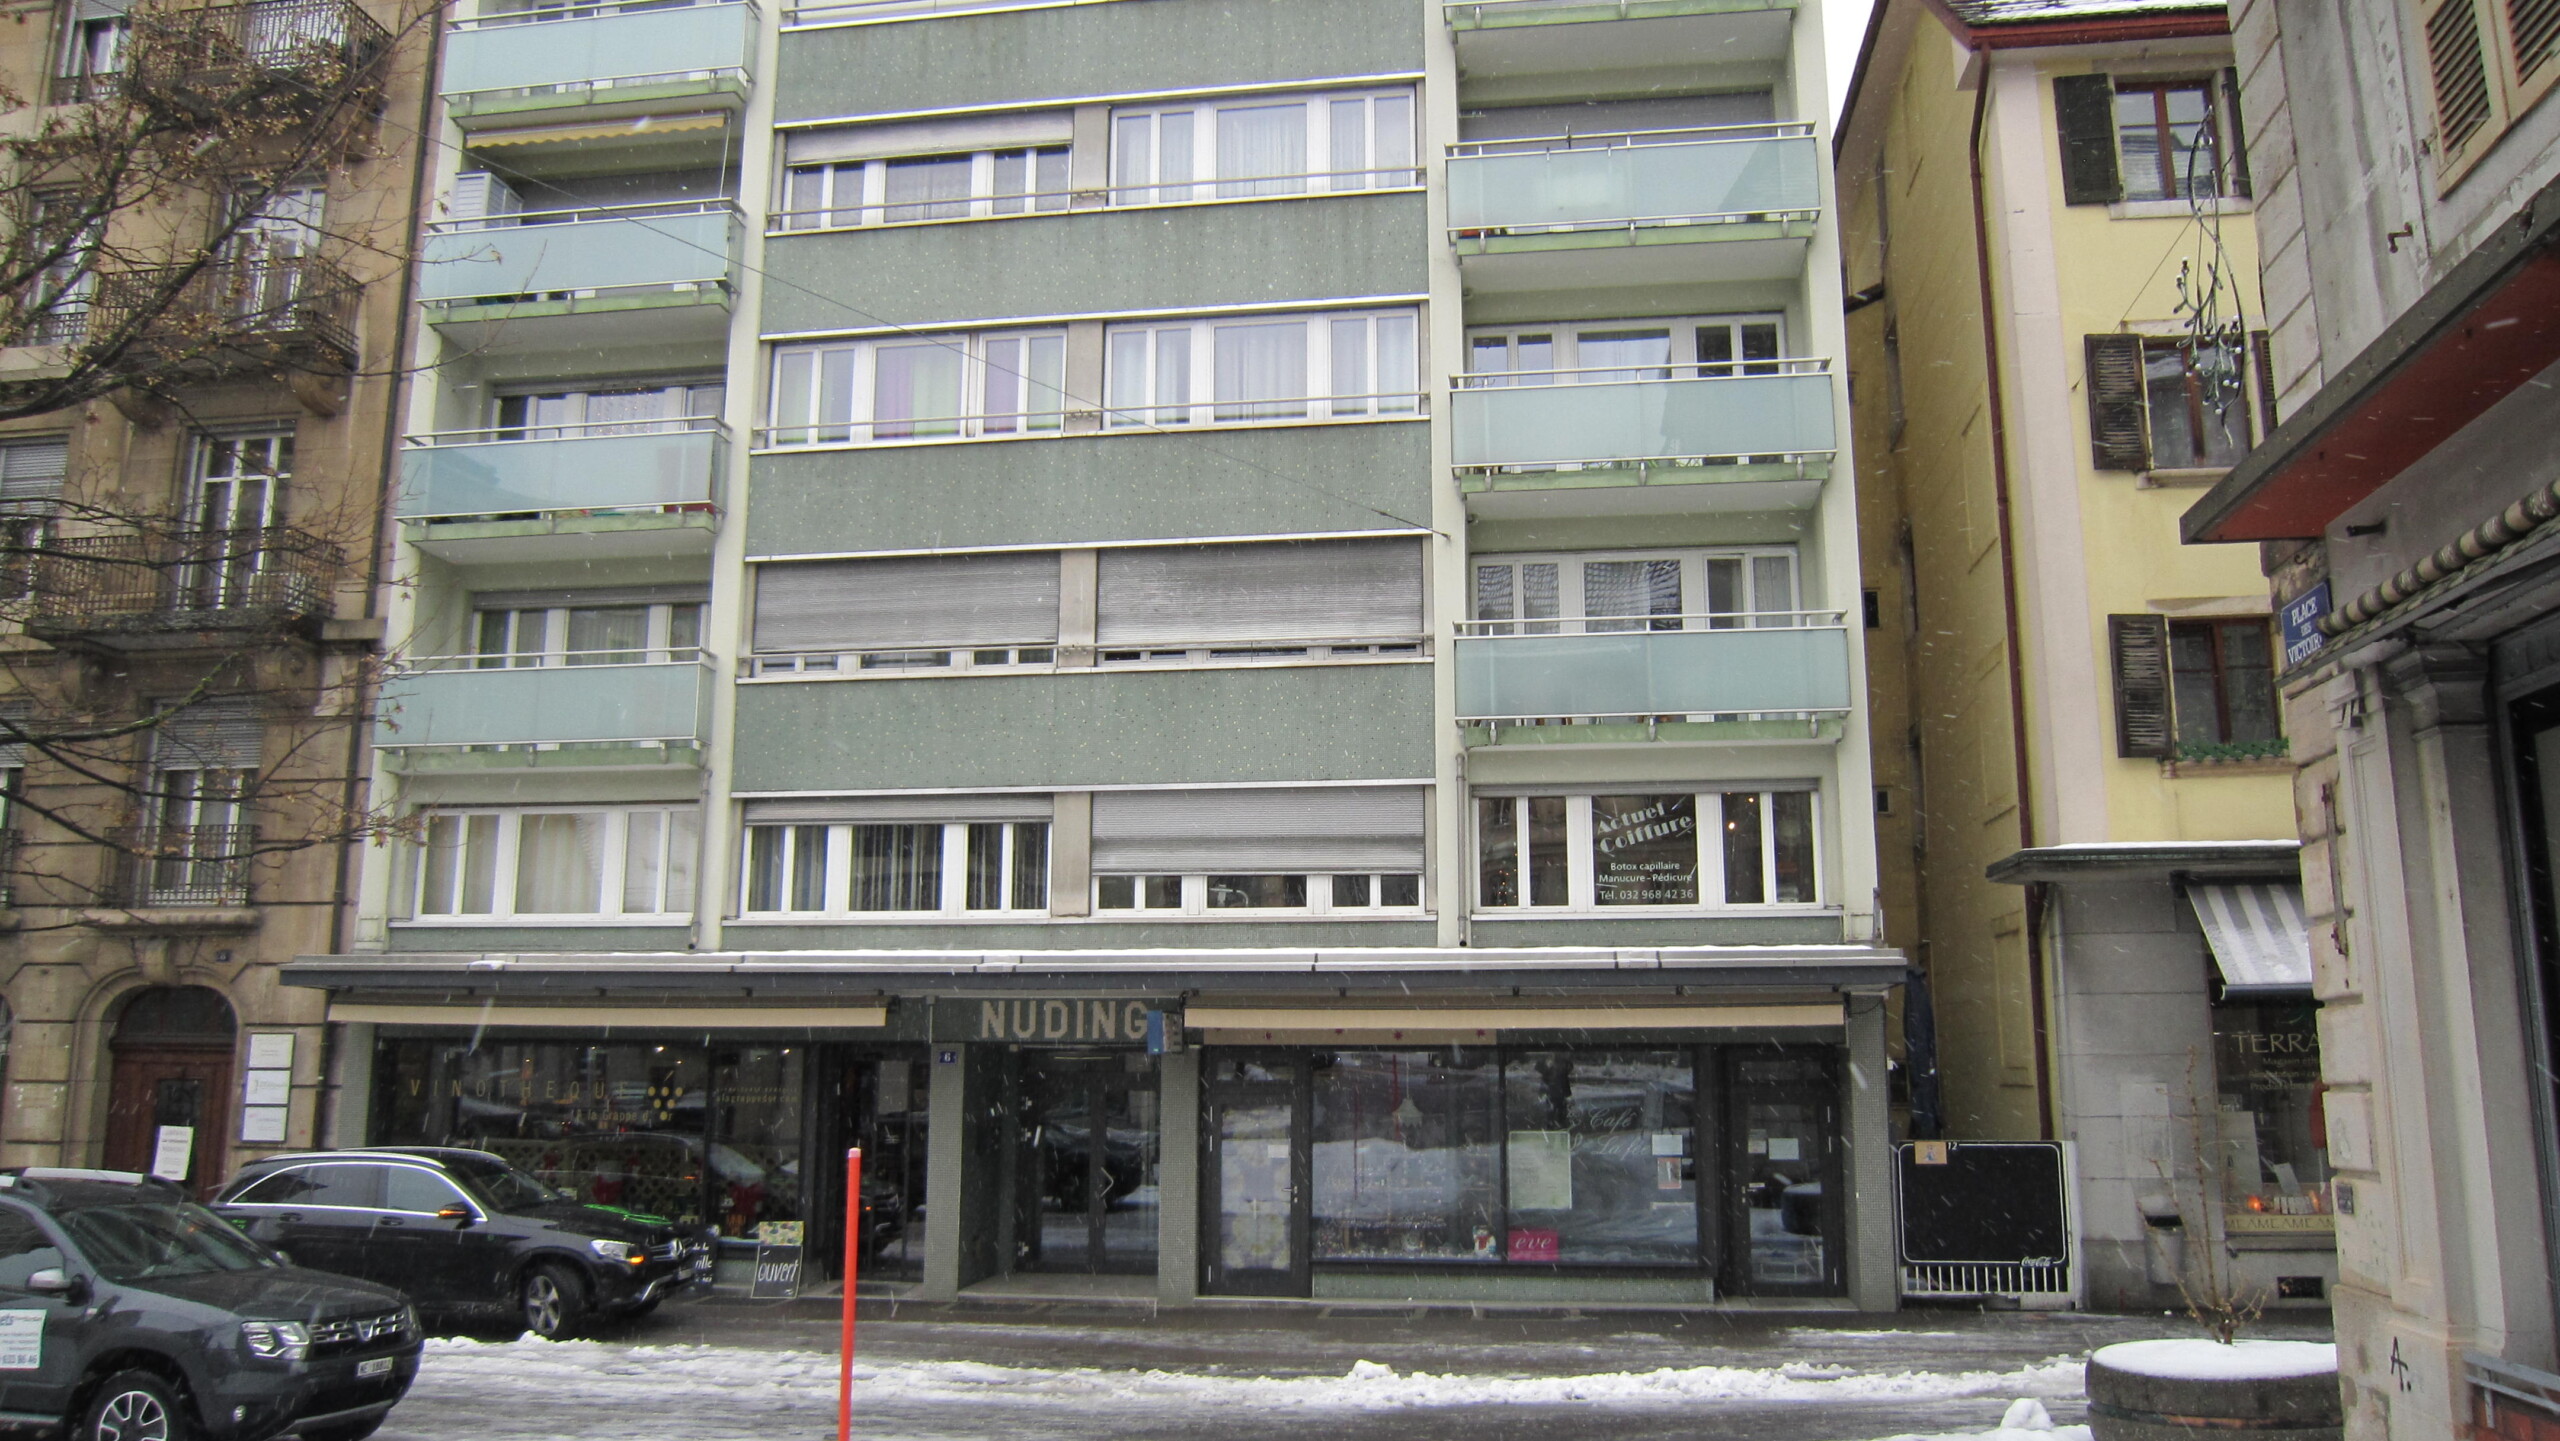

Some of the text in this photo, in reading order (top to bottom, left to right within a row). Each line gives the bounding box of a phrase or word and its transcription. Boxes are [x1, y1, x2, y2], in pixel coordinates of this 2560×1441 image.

[2291, 596, 2318, 627] PLACE
[1598, 802, 1665, 835] Actuel
[1600, 816, 1692, 853] Coiffure
[1610, 861, 1680, 873] Botox capillaire
[1600, 889, 1694, 900] Tél. 032 968 42 36
[981, 1000, 1148, 1039] NUDING
[944, 1053, 951, 1062] 6
[602, 1110, 638, 1123] Grappe
[1590, 1108, 1637, 1134] Café
[1515, 1238, 1552, 1249] eve
[758, 1260, 799, 1282] ouvert
